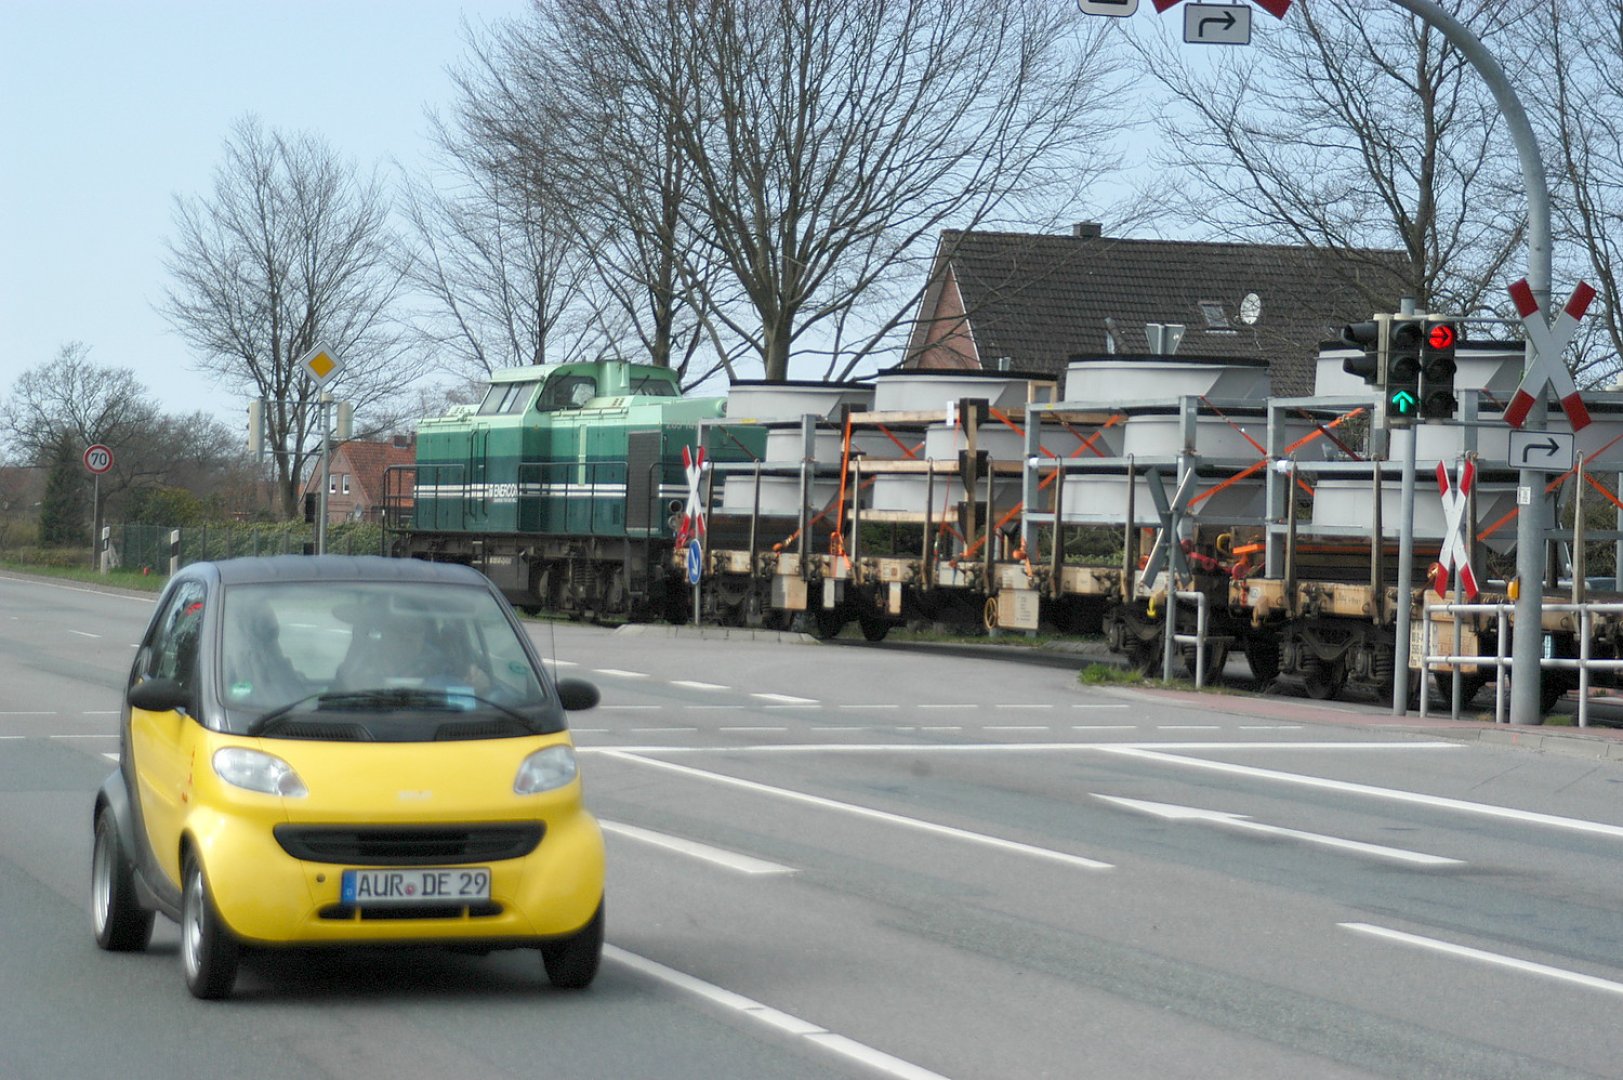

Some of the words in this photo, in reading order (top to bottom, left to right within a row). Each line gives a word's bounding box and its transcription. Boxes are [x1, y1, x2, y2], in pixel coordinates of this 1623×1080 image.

[91, 452, 107, 466] 70
[357, 873, 404, 897] AUR
[421, 872, 452, 896] DE
[458, 872, 488, 896] 29
